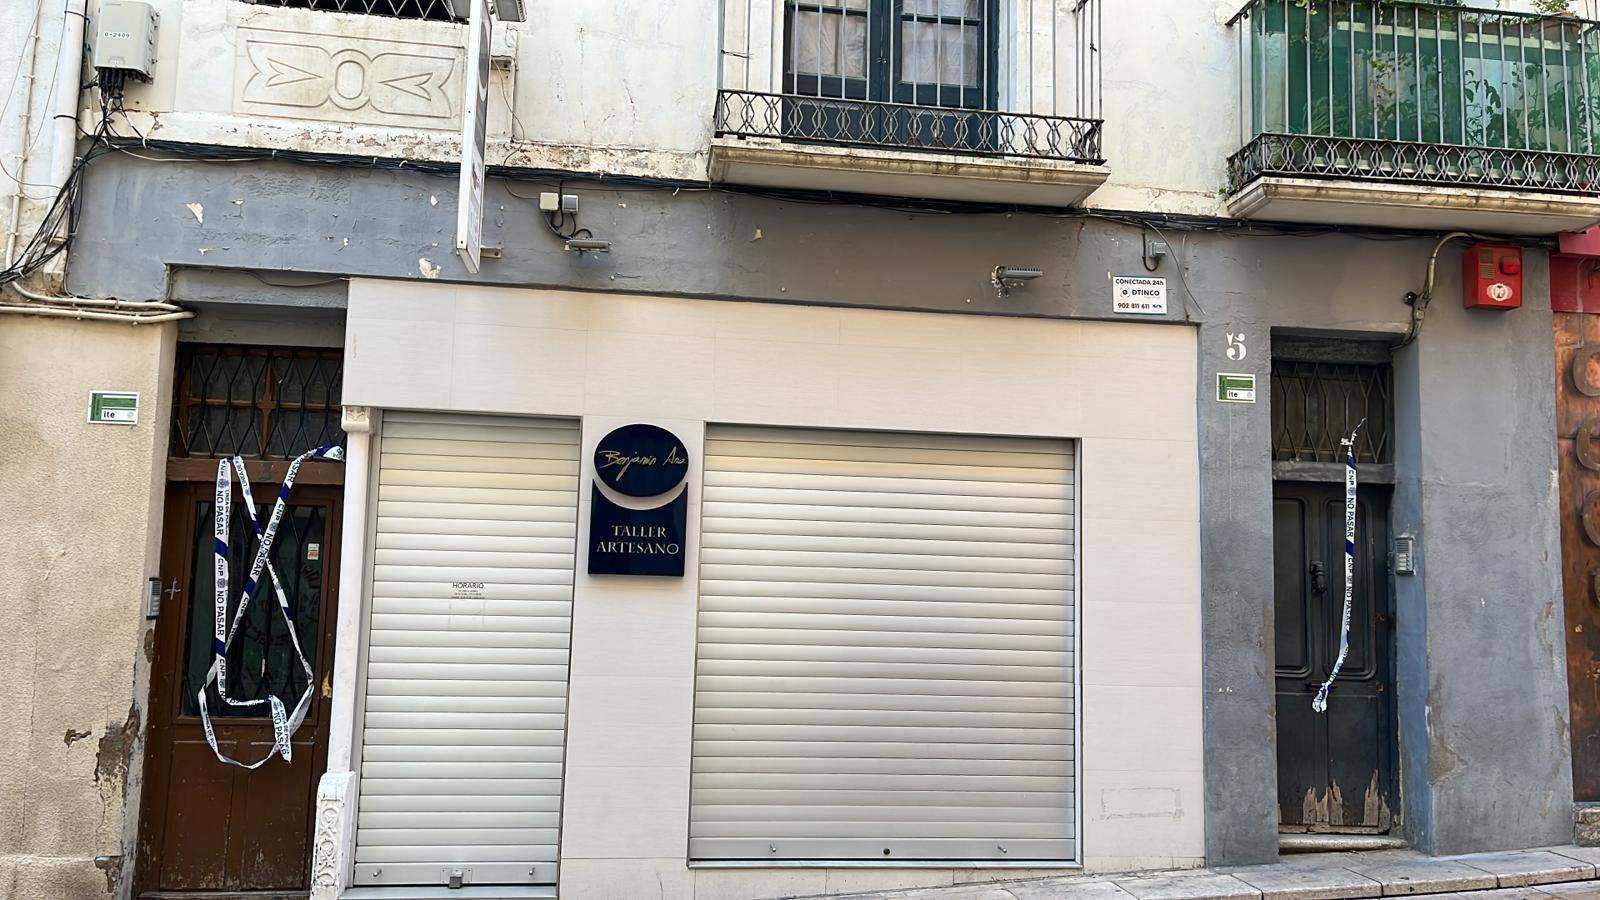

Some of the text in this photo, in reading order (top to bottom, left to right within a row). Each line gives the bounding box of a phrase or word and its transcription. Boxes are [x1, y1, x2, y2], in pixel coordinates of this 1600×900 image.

[1115, 278, 1151, 286] CONECTADA
[1226, 332, 1247, 361] 5
[216, 490, 224, 503] NO
[1347, 497, 1355, 509] NO
[216, 505, 224, 535] PASAR
[611, 525, 667, 538] TALLER
[596, 541, 679, 555] ARTESANO
[217, 590, 224, 603] NO
